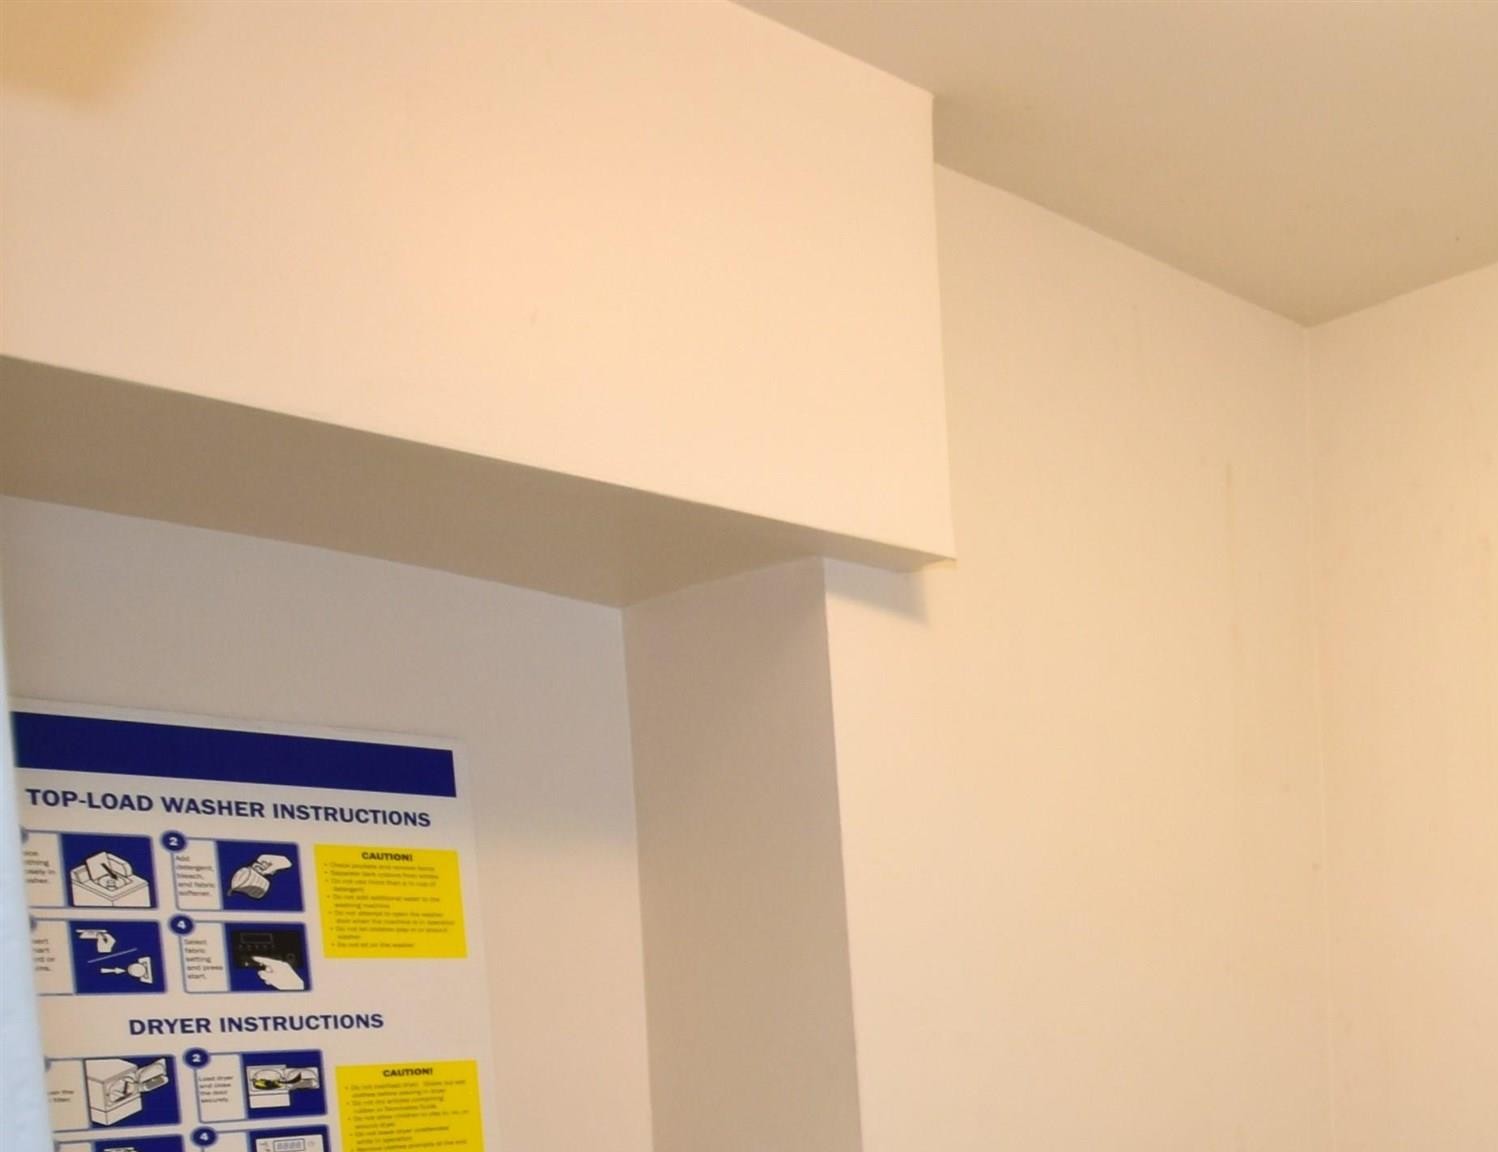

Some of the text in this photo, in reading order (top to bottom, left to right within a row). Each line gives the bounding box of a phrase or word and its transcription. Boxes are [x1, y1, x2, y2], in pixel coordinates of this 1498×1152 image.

[26, 788, 431, 827] TOP-LOAD WASHER INSTRUCTIONS
[169, 836, 179, 846] 2
[361, 851, 413, 861] CAUTION!
[177, 920, 186, 929] 4
[129, 1013, 384, 1037] DRYER INSTRUCTIONS
[192, 1053, 202, 1063] 2
[383, 1067, 433, 1077] CAUTION!
[200, 1132, 209, 1141] 4
